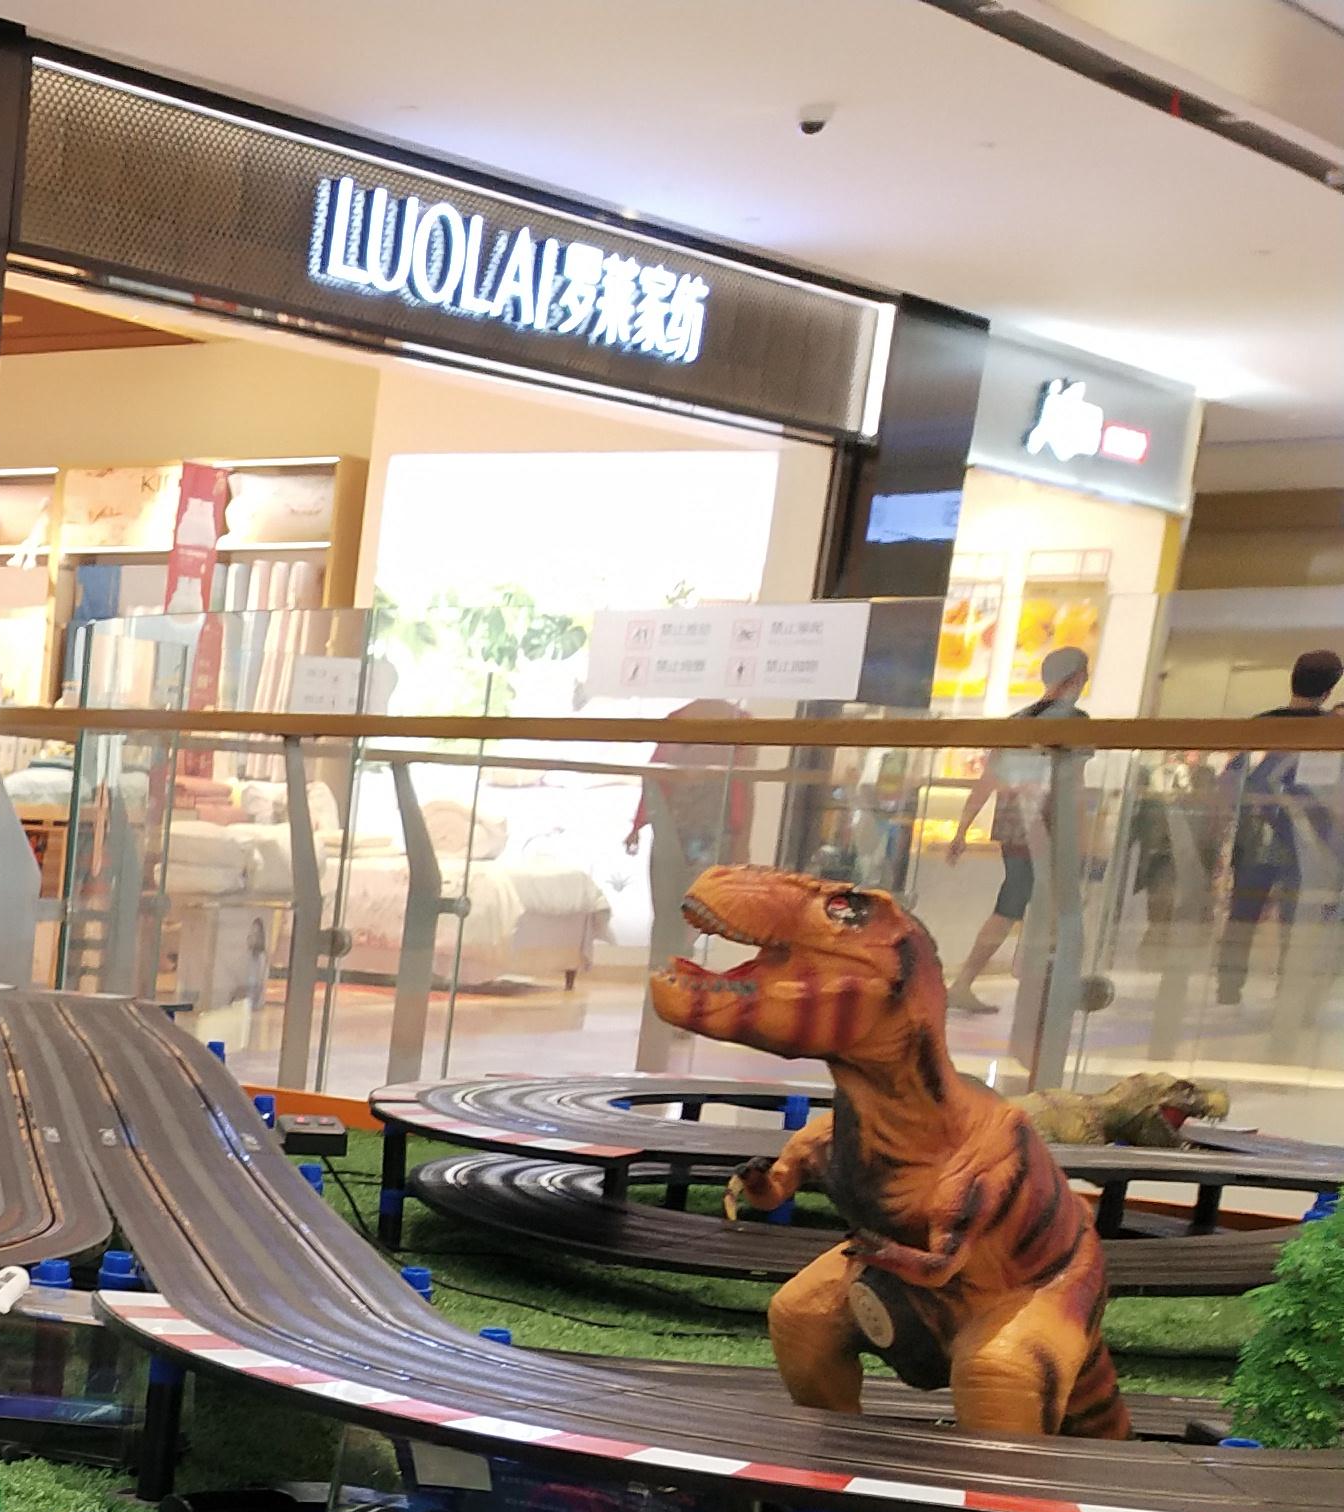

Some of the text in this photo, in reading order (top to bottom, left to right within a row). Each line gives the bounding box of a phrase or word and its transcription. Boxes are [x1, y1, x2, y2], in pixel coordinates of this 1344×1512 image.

[320, 176, 560, 331] LUOLAI
[559, 241, 710, 364] 罗莱家纺
